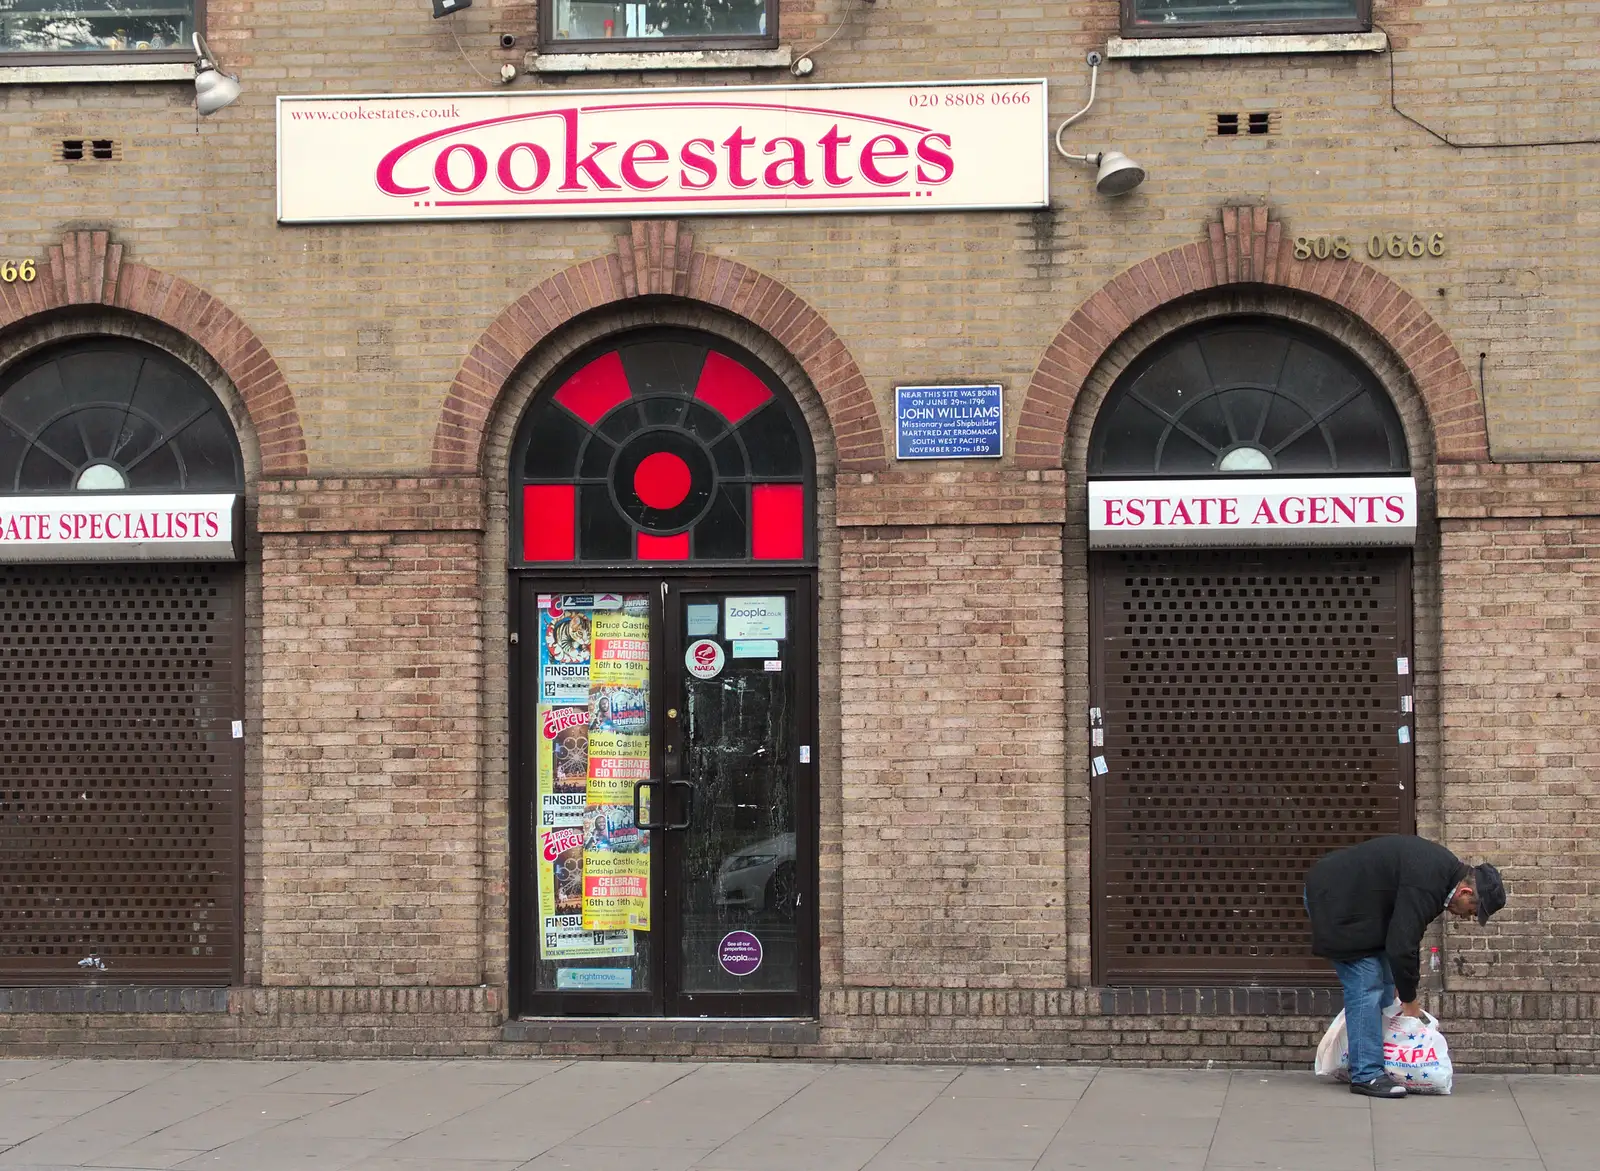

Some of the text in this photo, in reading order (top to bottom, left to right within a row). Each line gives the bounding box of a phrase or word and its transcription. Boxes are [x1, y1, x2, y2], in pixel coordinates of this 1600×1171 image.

[908, 90, 1031, 107] 020 8808 0666
[291, 104, 460, 121] www.cookestates.co.uk
[1293, 231, 1446, 260] 808 0666
[1, 258, 37, 283] 66
[901, 391, 922, 399] NEAR
[942, 390, 958, 398] SITE
[977, 389, 998, 397] BORN
[926, 398, 948, 406] JUNE
[969, 397, 986, 405] 1796
[899, 406, 1000, 420] JOHN WILLIAMS
[901, 419, 997, 429] Missionary and Shipbuilder
[901, 429, 942, 437] MARTYRED
[953, 428, 998, 436] ERROMANGA
[937, 437, 957, 445] WEST
[973, 445, 990, 453] 1839
[1103, 495, 1405, 526] ESTATE AGENTS
[0, 511, 219, 541] ATE SPECIALISTS
[595, 621, 650, 630] Bruce Castle
[602, 649, 615, 659] EID
[594, 661, 644, 670] 16th to 19th
[545, 666, 590, 676] FINSBUR
[546, 684, 555, 693] 12
[541, 707, 573, 722] ZIPPOS
[589, 739, 614, 748] Bruce
[616, 739, 643, 748] Castle
[601, 758, 650, 769] CELEBRATE
[595, 768, 610, 778] EID
[588, 780, 606, 788] 16th
[608, 780, 618, 788] to
[544, 813, 554, 822] 12
[541, 829, 573, 845] ZIPPOS
[585, 857, 649, 867] Bruce Castle Park
[585, 867, 614, 875] Lordship
[598, 877, 640, 887] CELEBRATE
[592, 886, 608, 896] EID
[585, 898, 604, 907] 16th
[606, 899, 615, 907] to
[633, 899, 645, 908] July
[547, 937, 557, 946] 12
[594, 933, 604, 943] 17
